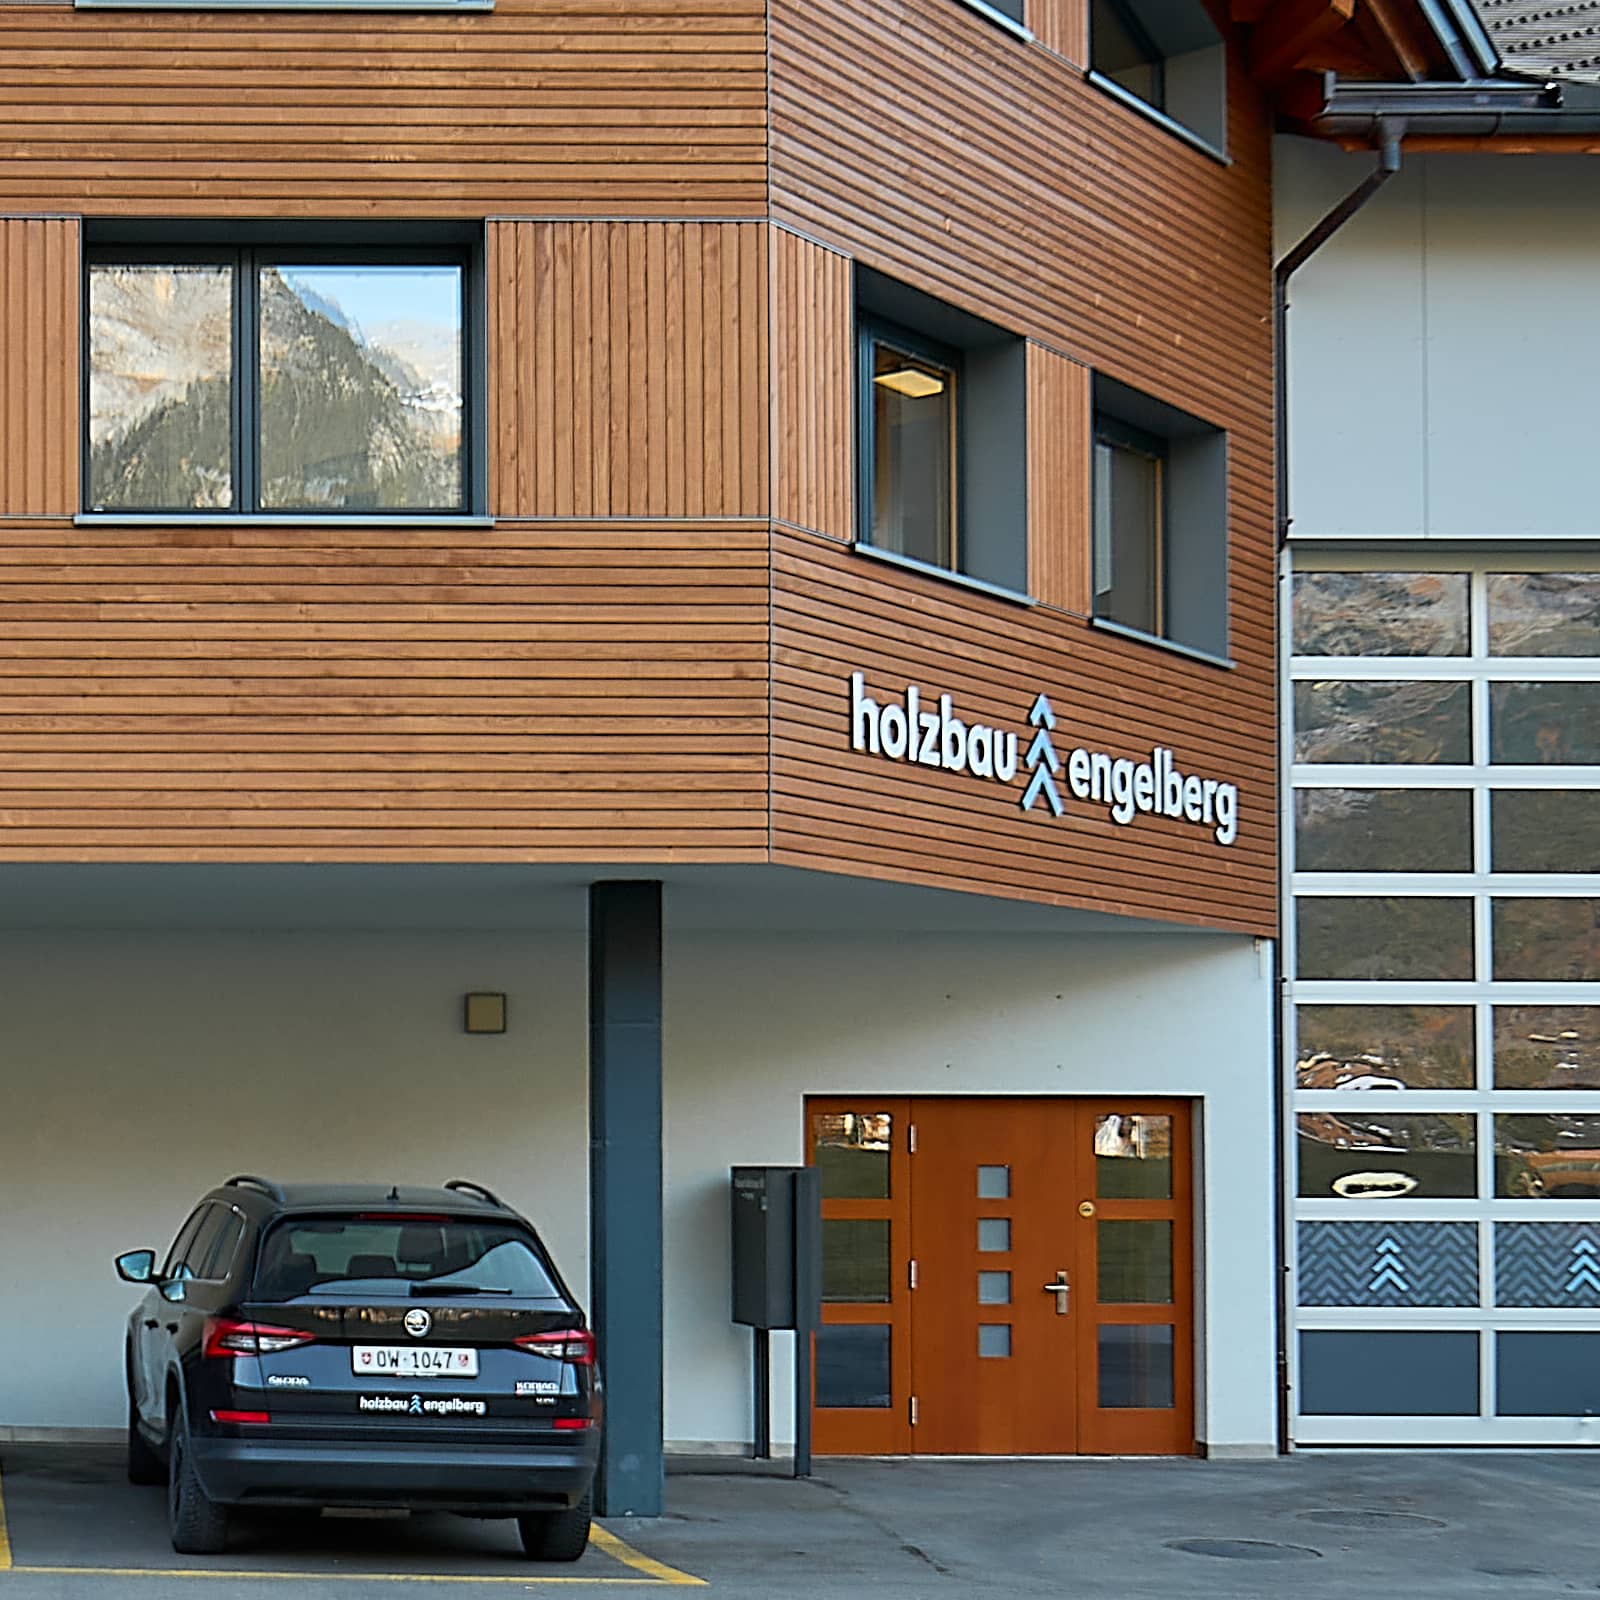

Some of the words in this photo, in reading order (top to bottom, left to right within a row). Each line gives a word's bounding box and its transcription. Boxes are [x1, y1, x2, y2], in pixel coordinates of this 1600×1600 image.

[850, 670, 1018, 782] holzbau
[1068, 746, 1237, 846] engelberg
[360, 1396, 408, 1410] holzbau
[423, 1399, 486, 1415] engelberg
